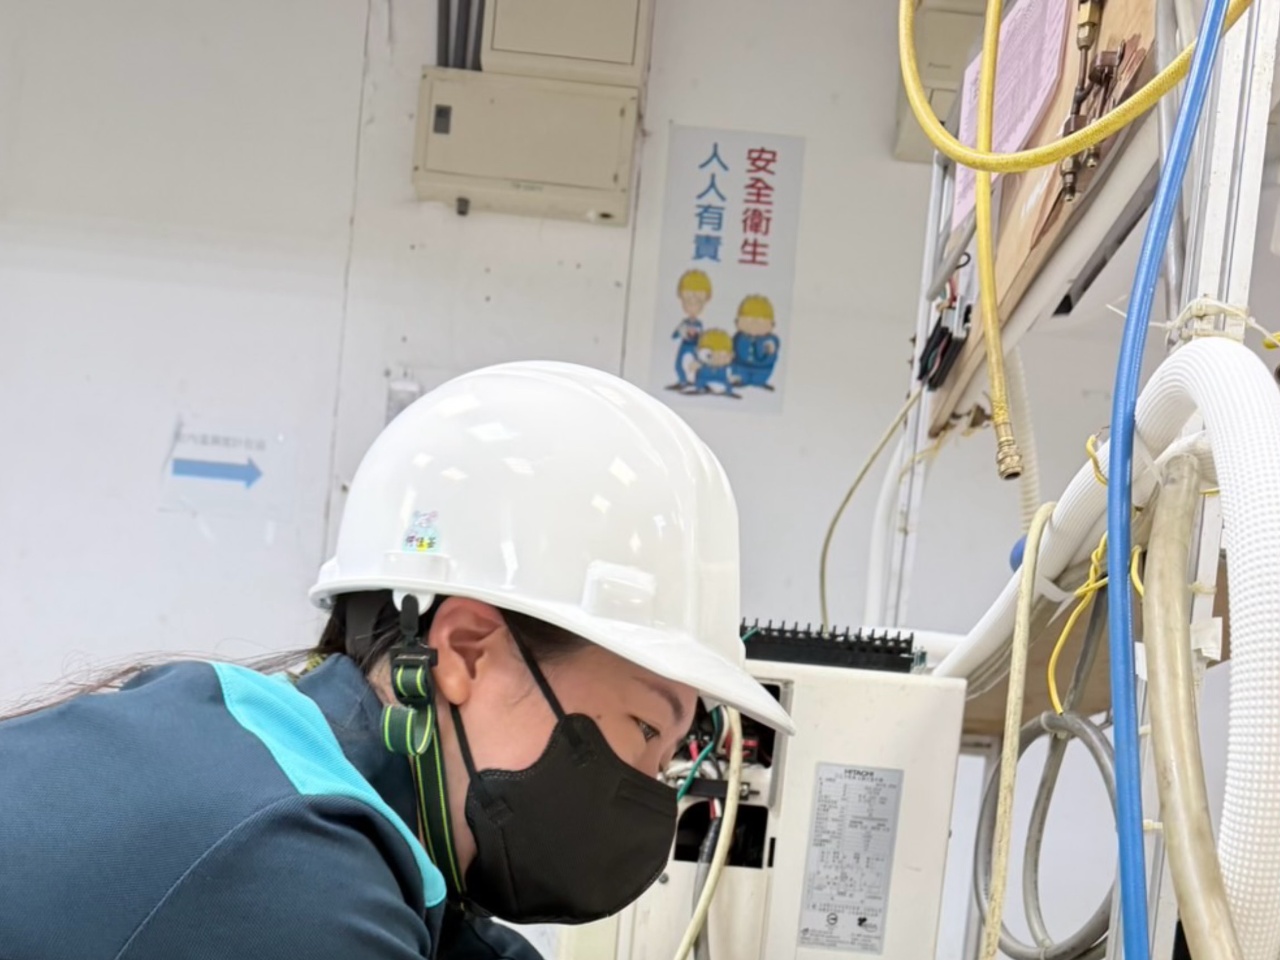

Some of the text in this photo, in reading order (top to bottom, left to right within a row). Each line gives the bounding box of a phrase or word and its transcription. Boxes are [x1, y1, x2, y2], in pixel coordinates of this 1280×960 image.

[692, 143, 729, 262] 人人有責
[738, 147, 777, 266] 安全衛生
